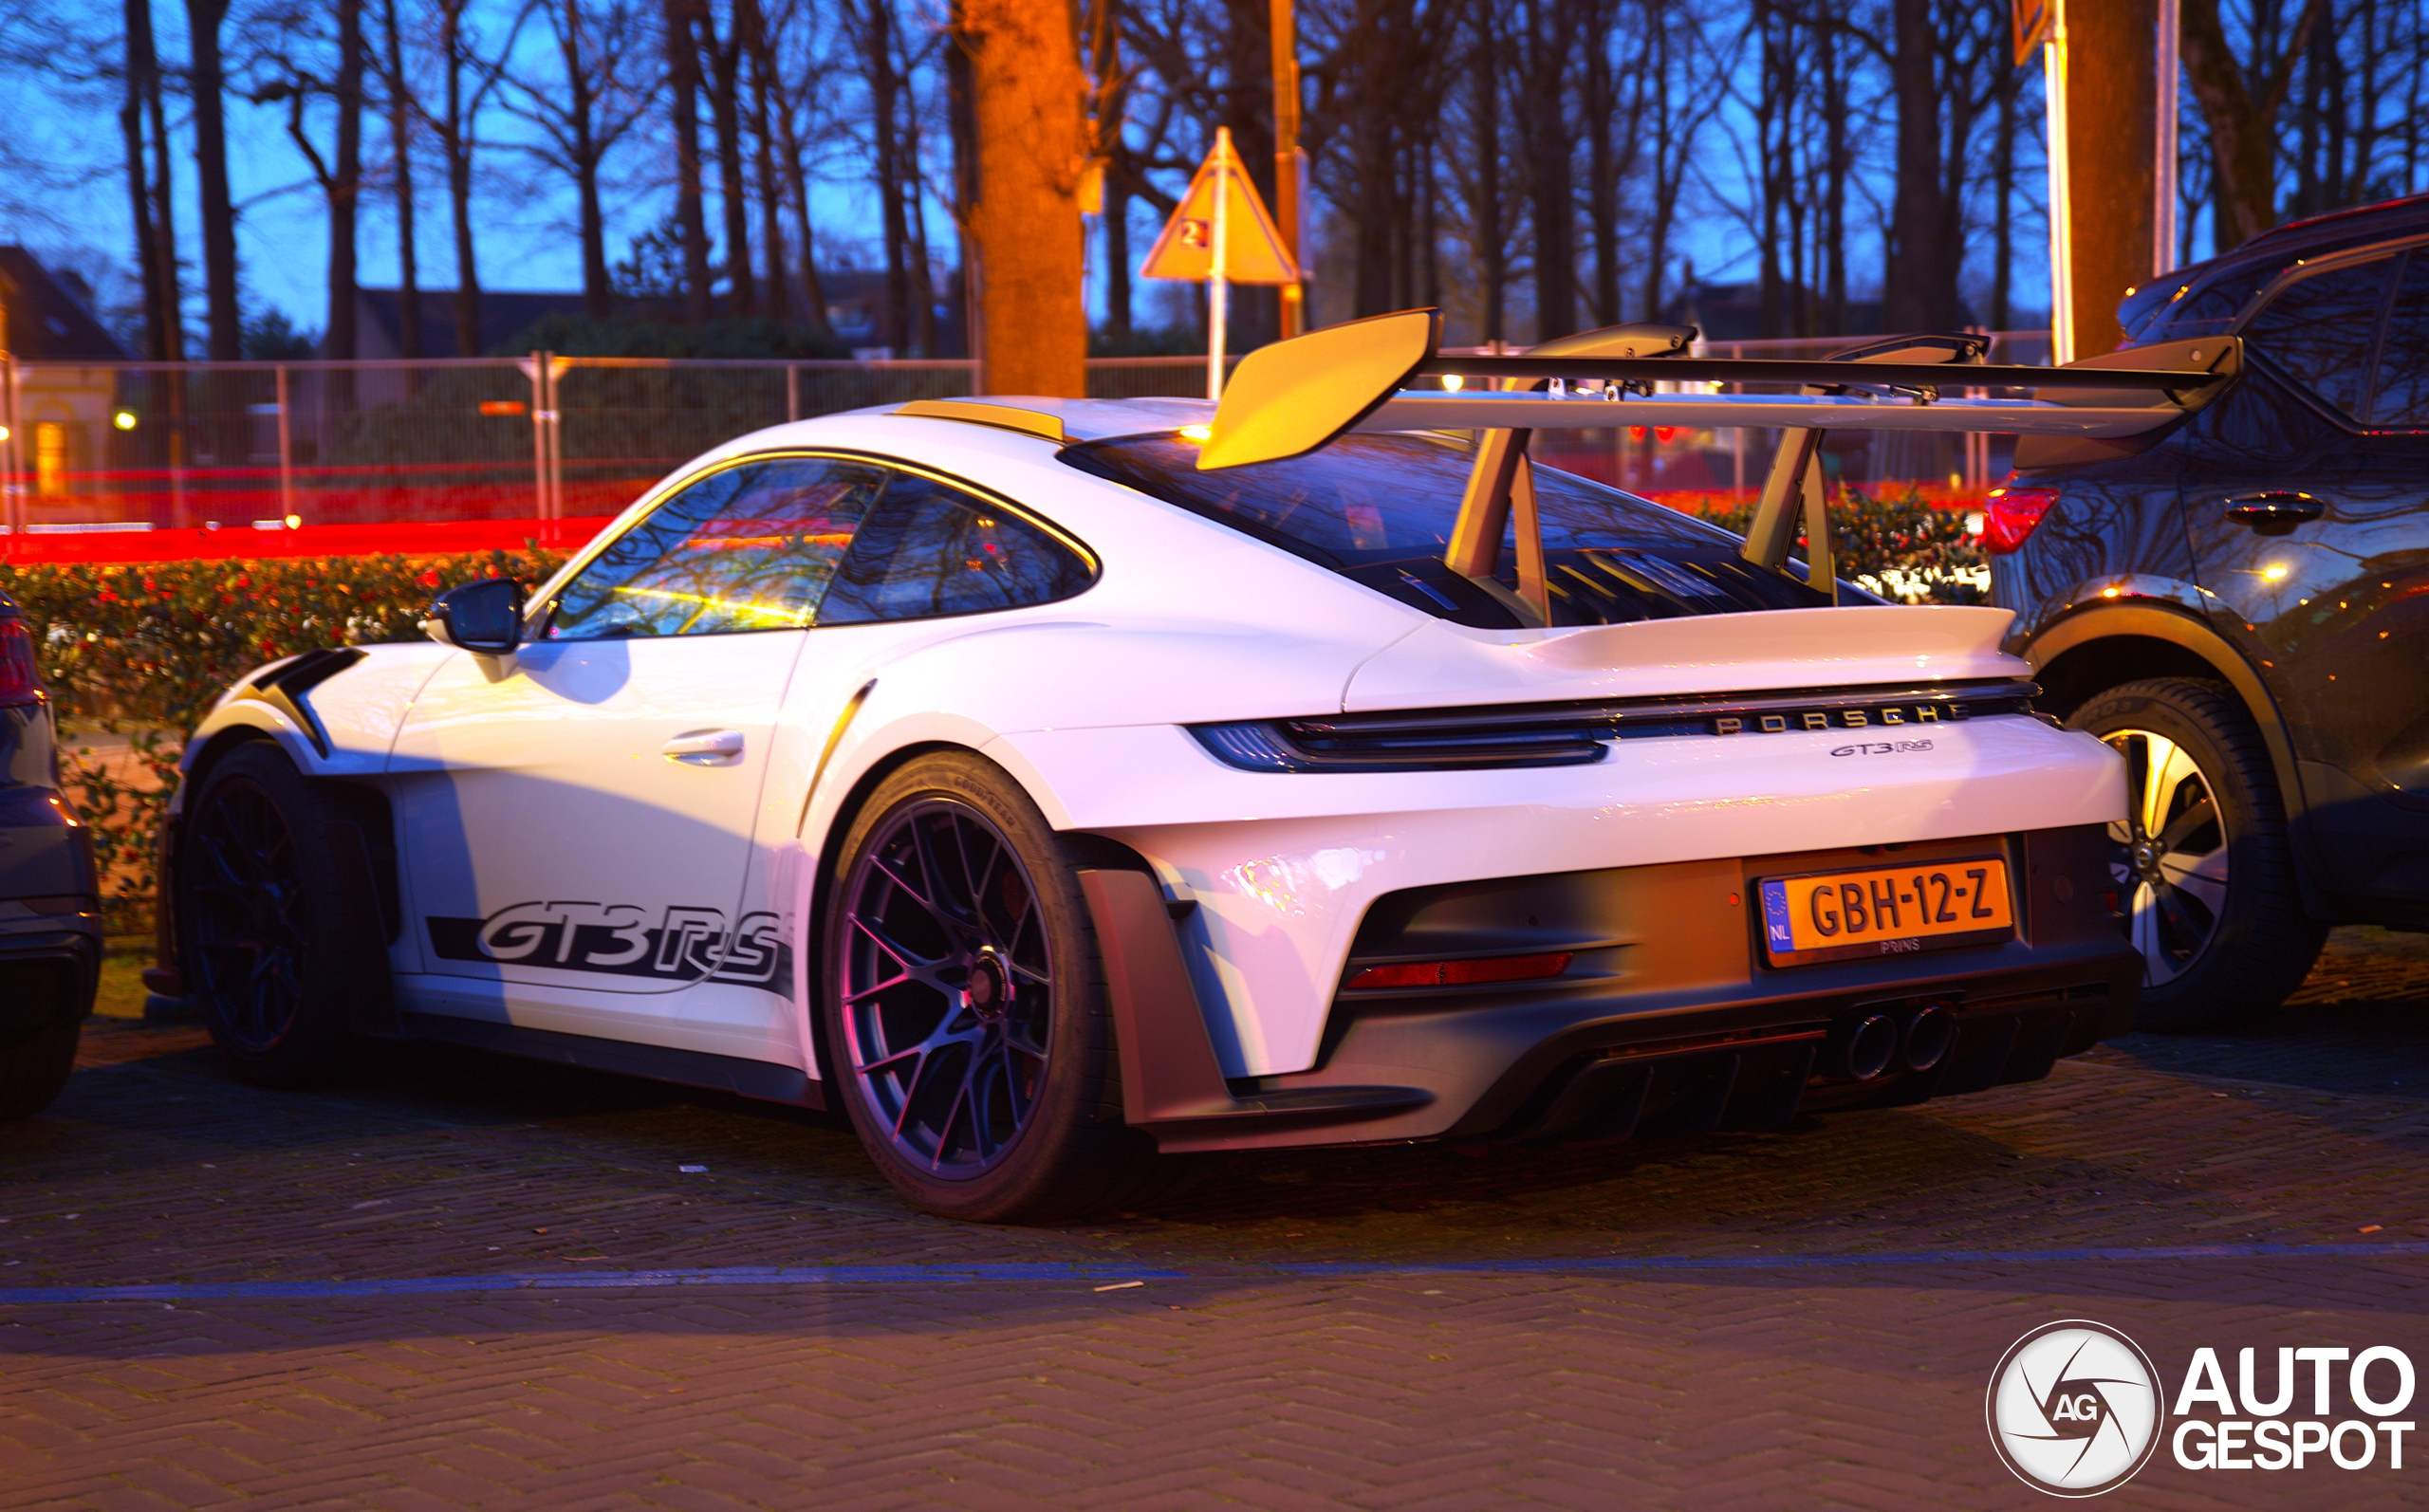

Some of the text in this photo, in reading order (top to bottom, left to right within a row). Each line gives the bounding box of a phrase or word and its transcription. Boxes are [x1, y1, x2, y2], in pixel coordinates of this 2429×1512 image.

[1715, 704, 1971, 735] PORSCHE
[1810, 868, 1993, 937] GBH-12-Z
[1770, 924, 1790, 941] NL
[1881, 938, 1920, 954] PRINS
